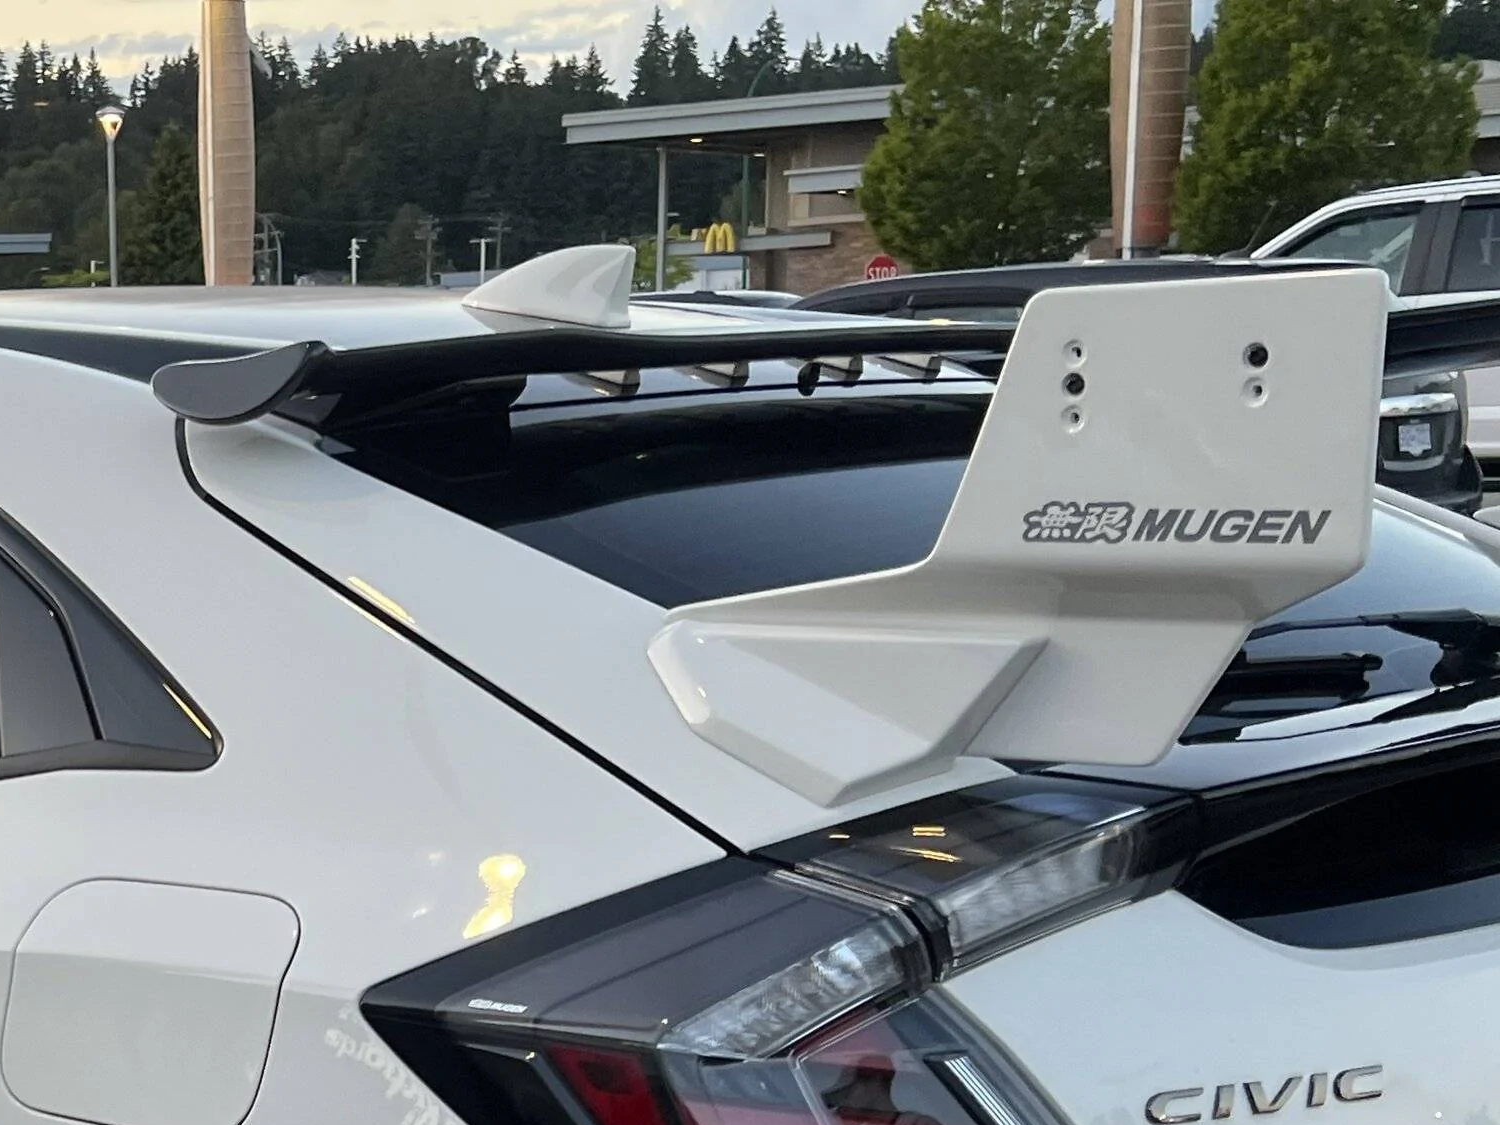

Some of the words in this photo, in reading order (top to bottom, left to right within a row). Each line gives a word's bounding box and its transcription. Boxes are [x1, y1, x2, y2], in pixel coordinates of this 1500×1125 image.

[868, 266, 898, 280] STOP
[1022, 501, 1135, 544] 無限
[1131, 508, 1332, 544] MUGEN
[1144, 1064, 1383, 1125] CIVIC
